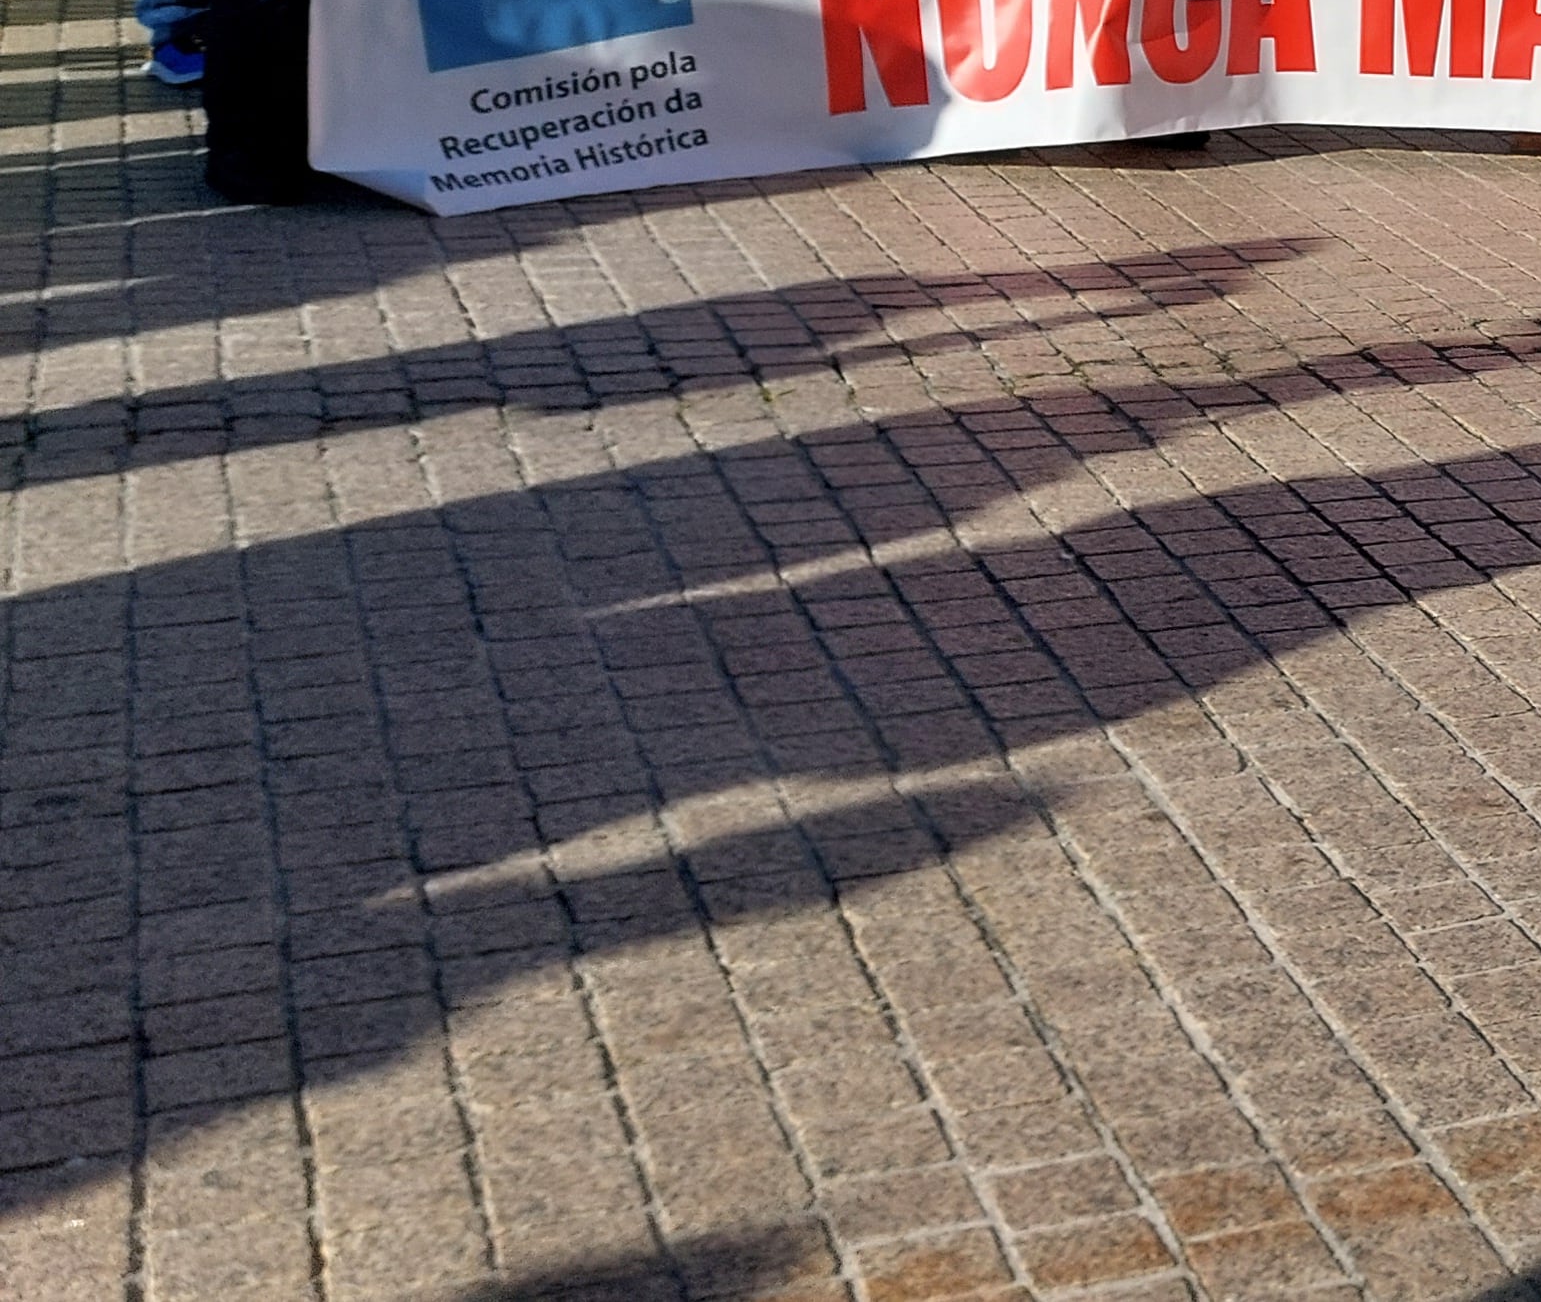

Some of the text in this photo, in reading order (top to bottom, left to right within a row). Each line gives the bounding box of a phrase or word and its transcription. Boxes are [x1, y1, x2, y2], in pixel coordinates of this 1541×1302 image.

[469, 51, 697, 115] Comisión pola
[439, 88, 704, 161] Recuperación da
[430, 126, 710, 194] Memoria Histórica
